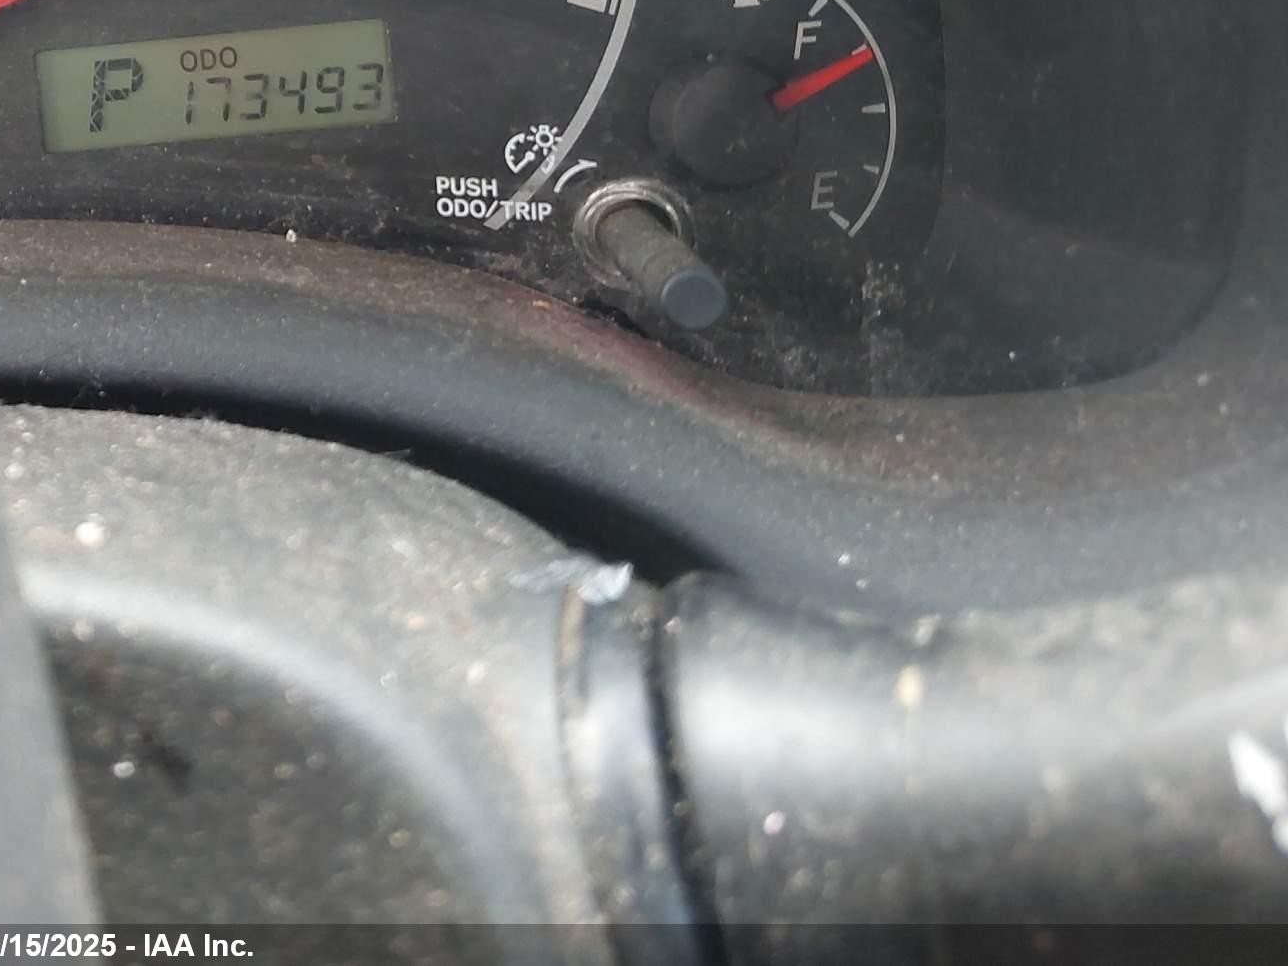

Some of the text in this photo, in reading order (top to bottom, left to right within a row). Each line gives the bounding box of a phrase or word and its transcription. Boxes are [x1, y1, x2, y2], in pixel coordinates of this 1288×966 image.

[794, 20, 822, 60] F
[179, 46, 238, 72] ODO
[89, 57, 384, 132] P 173493
[436, 176, 498, 198] PUSH
[811, 170, 838, 210] E
[436, 197, 553, 222] ODO/TRIP
